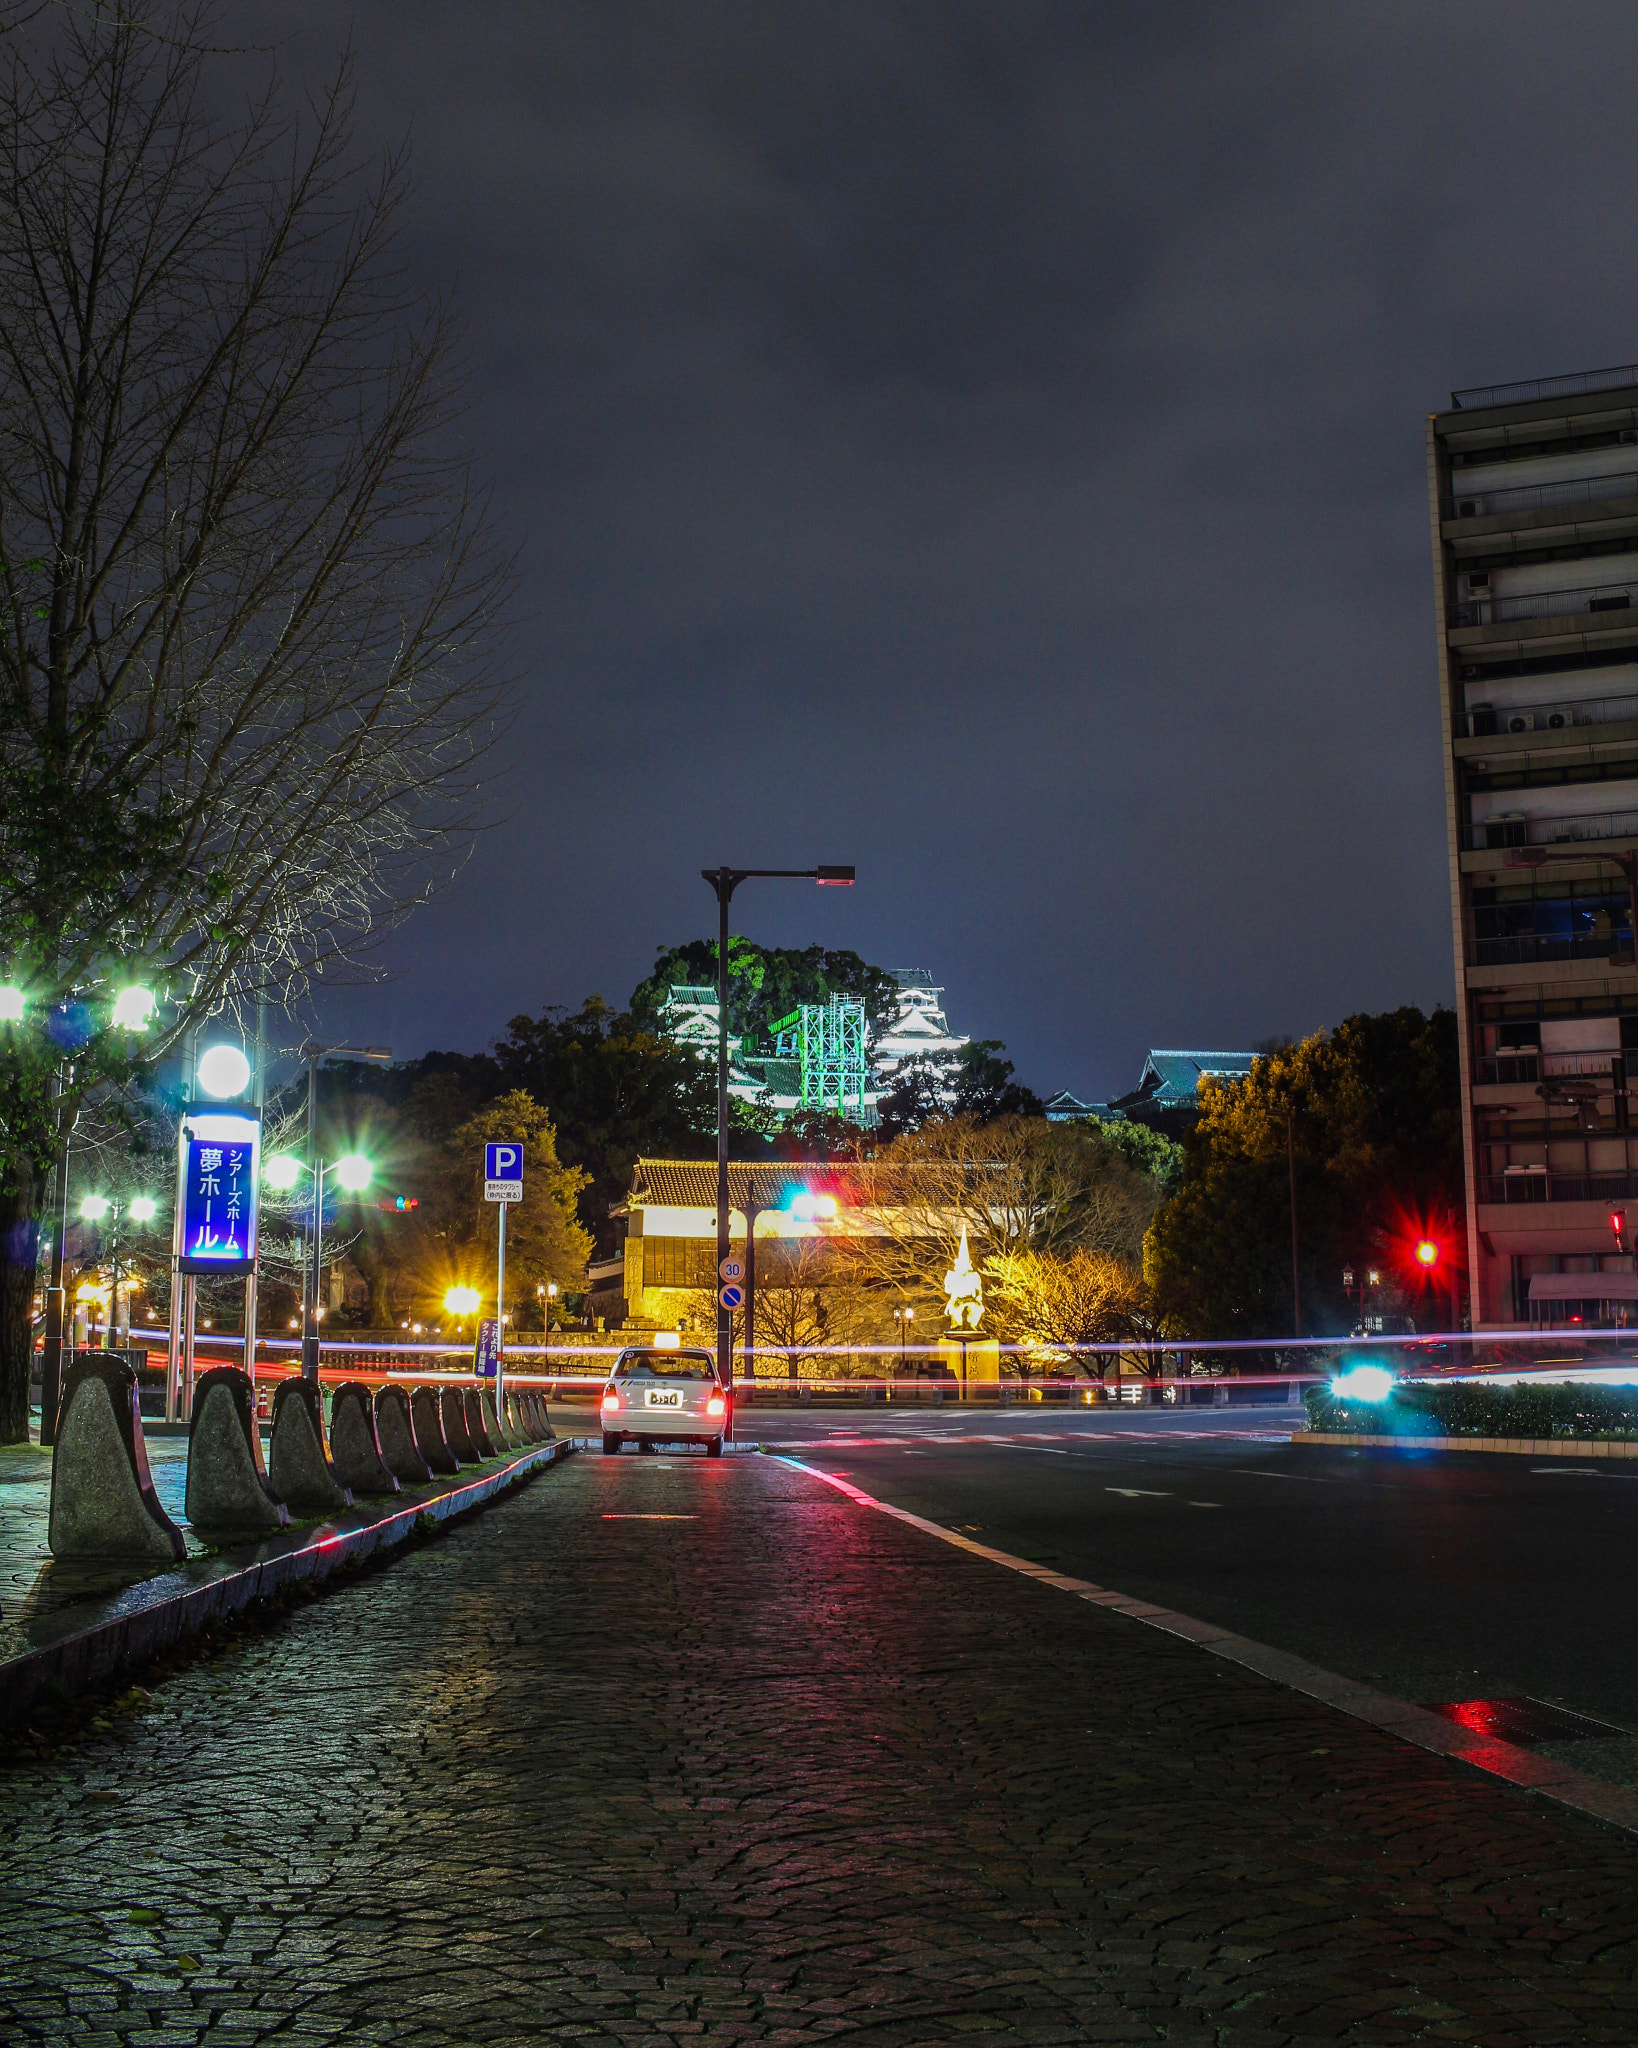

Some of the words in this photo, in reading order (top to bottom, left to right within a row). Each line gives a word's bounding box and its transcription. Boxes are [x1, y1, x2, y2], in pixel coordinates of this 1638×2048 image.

[495, 1147, 517, 1177] P
[194, 1147, 224, 1249] 夢ホール
[224, 1149, 243, 1250] シアーズホーム
[725, 1264, 740, 1276] 30
